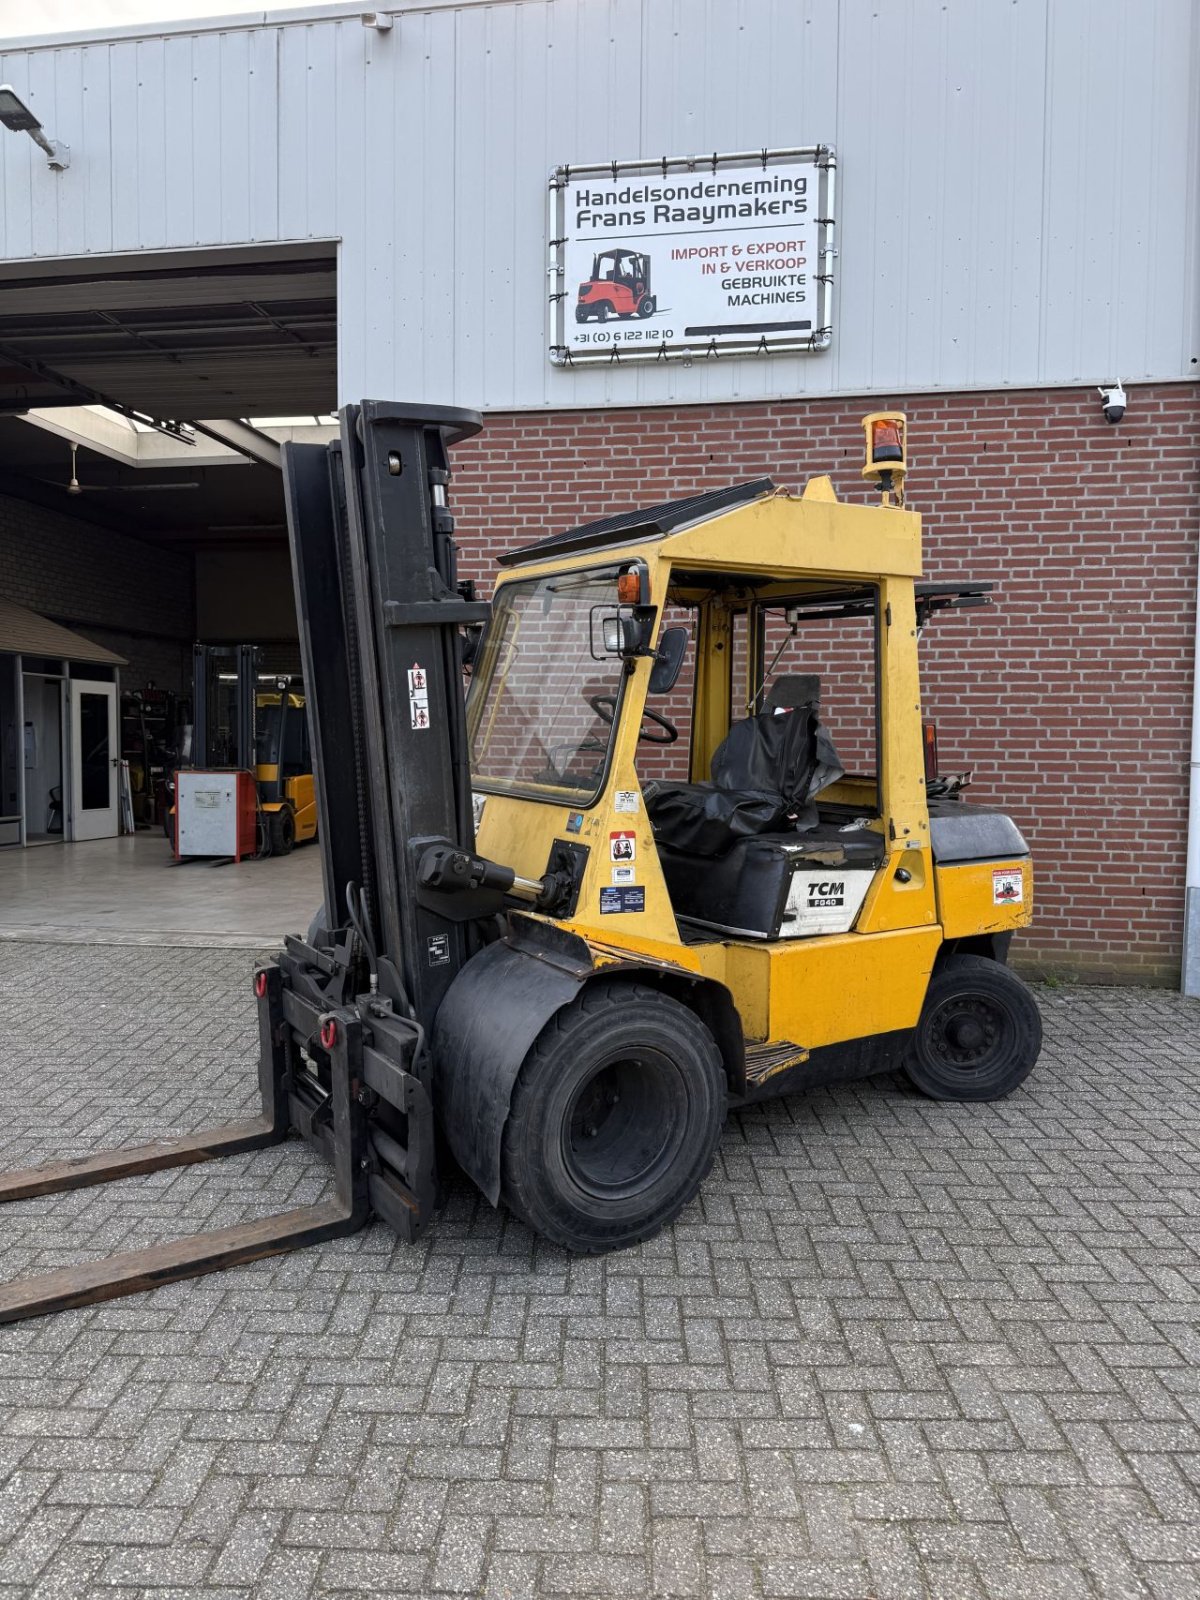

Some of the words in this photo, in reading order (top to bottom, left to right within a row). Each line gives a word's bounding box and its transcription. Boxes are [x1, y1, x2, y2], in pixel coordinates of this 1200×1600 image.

[576, 175, 807, 207] Handelsonderneming
[576, 209, 646, 229] Frans
[653, 197, 808, 225] Raaymakers
[671, 245, 728, 260] IMPORT
[731, 245, 743, 256] &
[746, 240, 806, 255] EXPORT
[702, 263, 716, 275] IN
[720, 262, 731, 273] &
[735, 257, 807, 272] VERKOOP
[721, 274, 806, 290] GEBRUIKTE
[727, 291, 806, 307] MACHINES
[573, 333, 590, 343] +31
[592, 332, 611, 343] (0)
[613, 332, 621, 341] 6
[624, 331, 642, 341] 122
[645, 330, 659, 339] 112
[662, 329, 674, 339] 10
[807, 882, 844, 896] TCM
